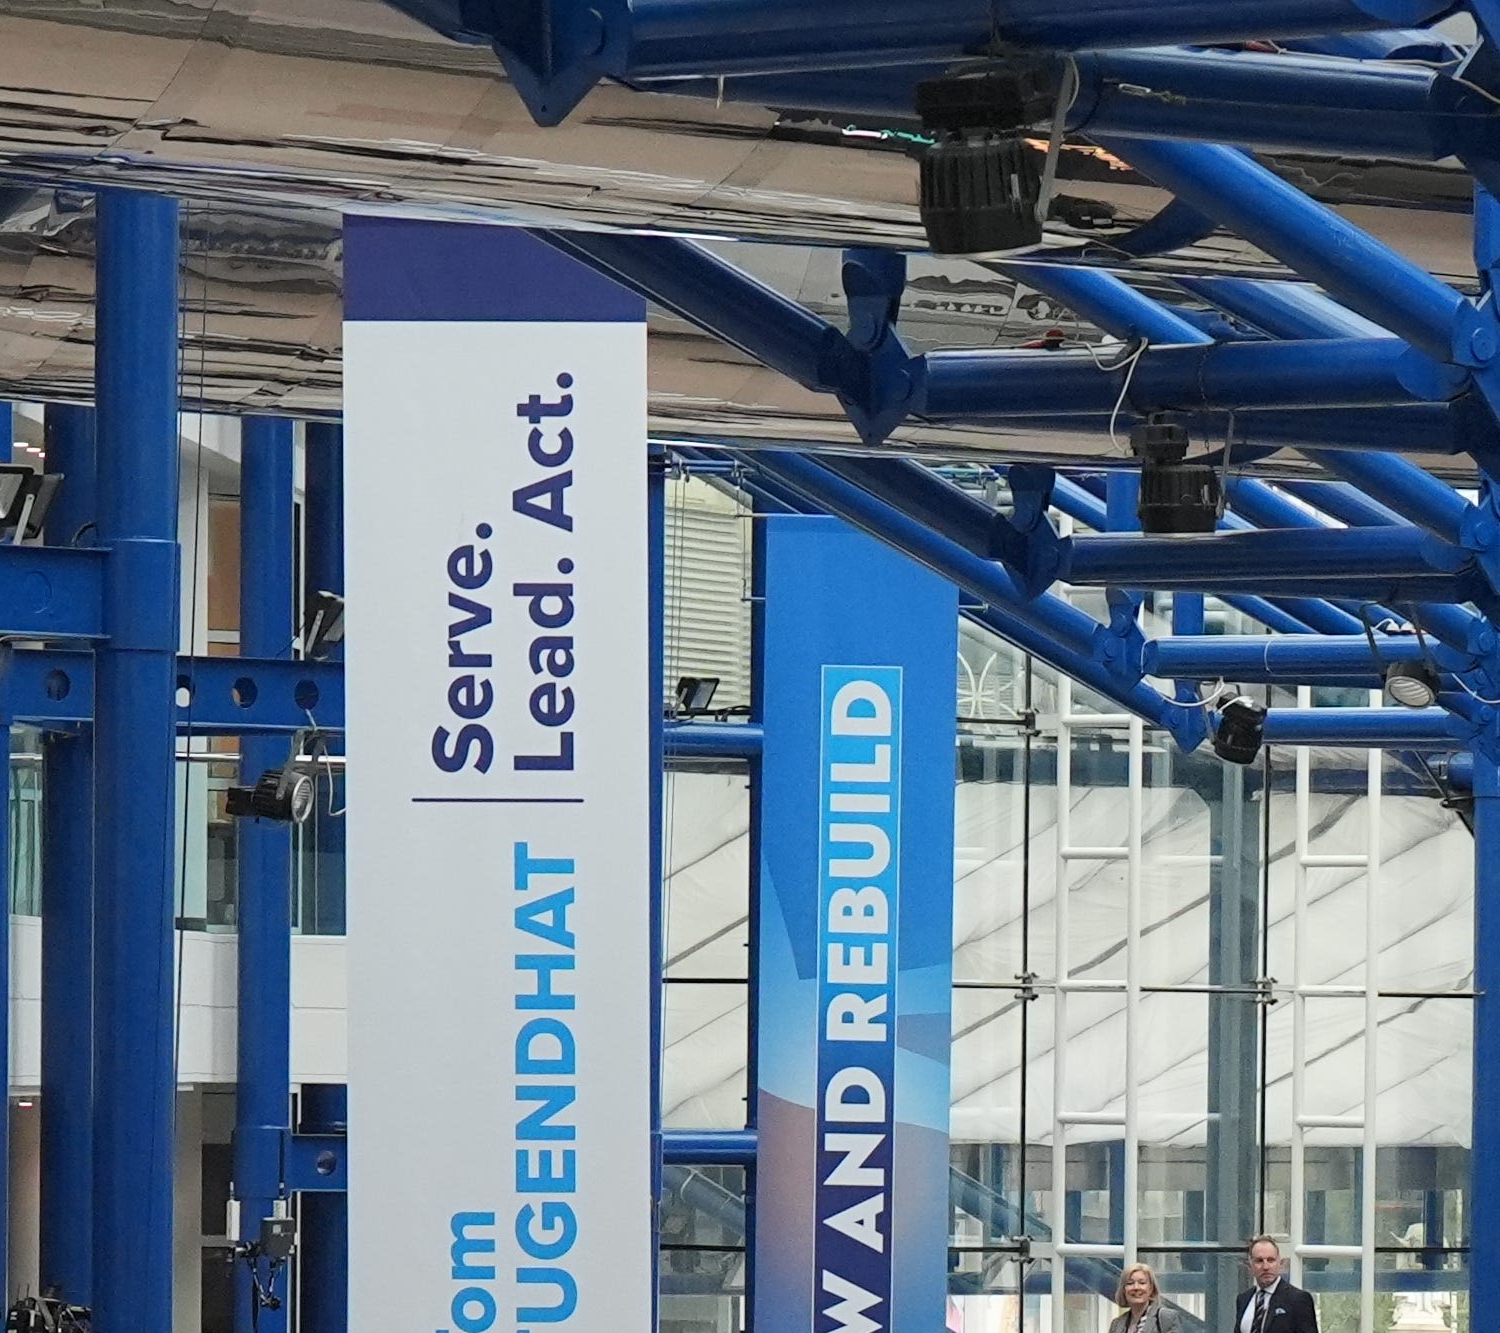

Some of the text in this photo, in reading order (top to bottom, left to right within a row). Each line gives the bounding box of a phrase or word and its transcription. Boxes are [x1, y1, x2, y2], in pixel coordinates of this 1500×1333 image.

[431, 521, 494, 776] Serve.
[512, 371, 576, 772] Lead. Act.
[825, 679, 893, 1043] REBUILD
[823, 1066, 887, 1254] AND
